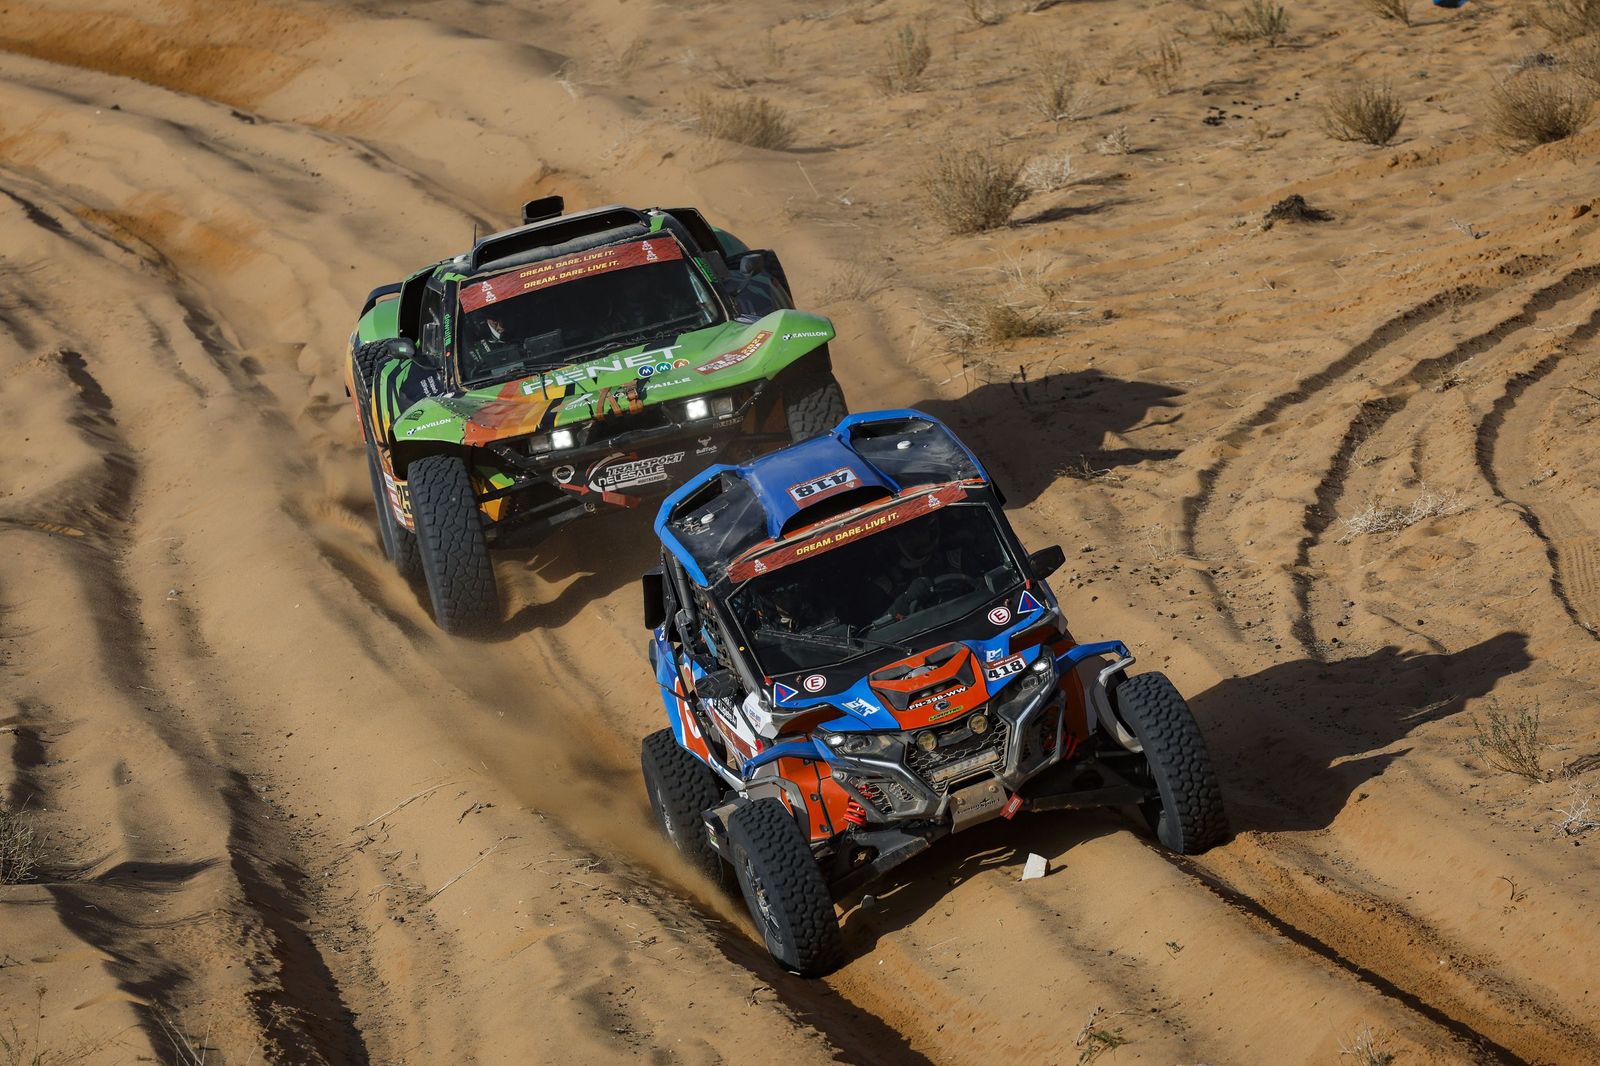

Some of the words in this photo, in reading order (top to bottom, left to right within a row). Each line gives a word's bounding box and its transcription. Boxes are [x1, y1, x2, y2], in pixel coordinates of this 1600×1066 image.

[519, 264, 554, 279] DREAM.
[555, 257, 582, 269] DARE.
[583, 252, 603, 262] LIVE
[604, 249, 616, 257] IT.
[523, 275, 558, 289] DREAM.
[559, 268, 586, 279] DARE.
[587, 262, 608, 272] LIVE
[608, 259, 620, 268] IT.
[522, 344, 682, 396] PENET
[598, 464, 665, 487] DELESALLE
[605, 451, 685, 477] TRANSPORT
[794, 472, 849, 498] 418
[796, 538, 834, 556] DREAM.
[835, 527, 864, 541] DARE.
[865, 517, 887, 530] LIVE
[888, 512, 900, 522] IT.
[988, 660, 1023, 679] 418
